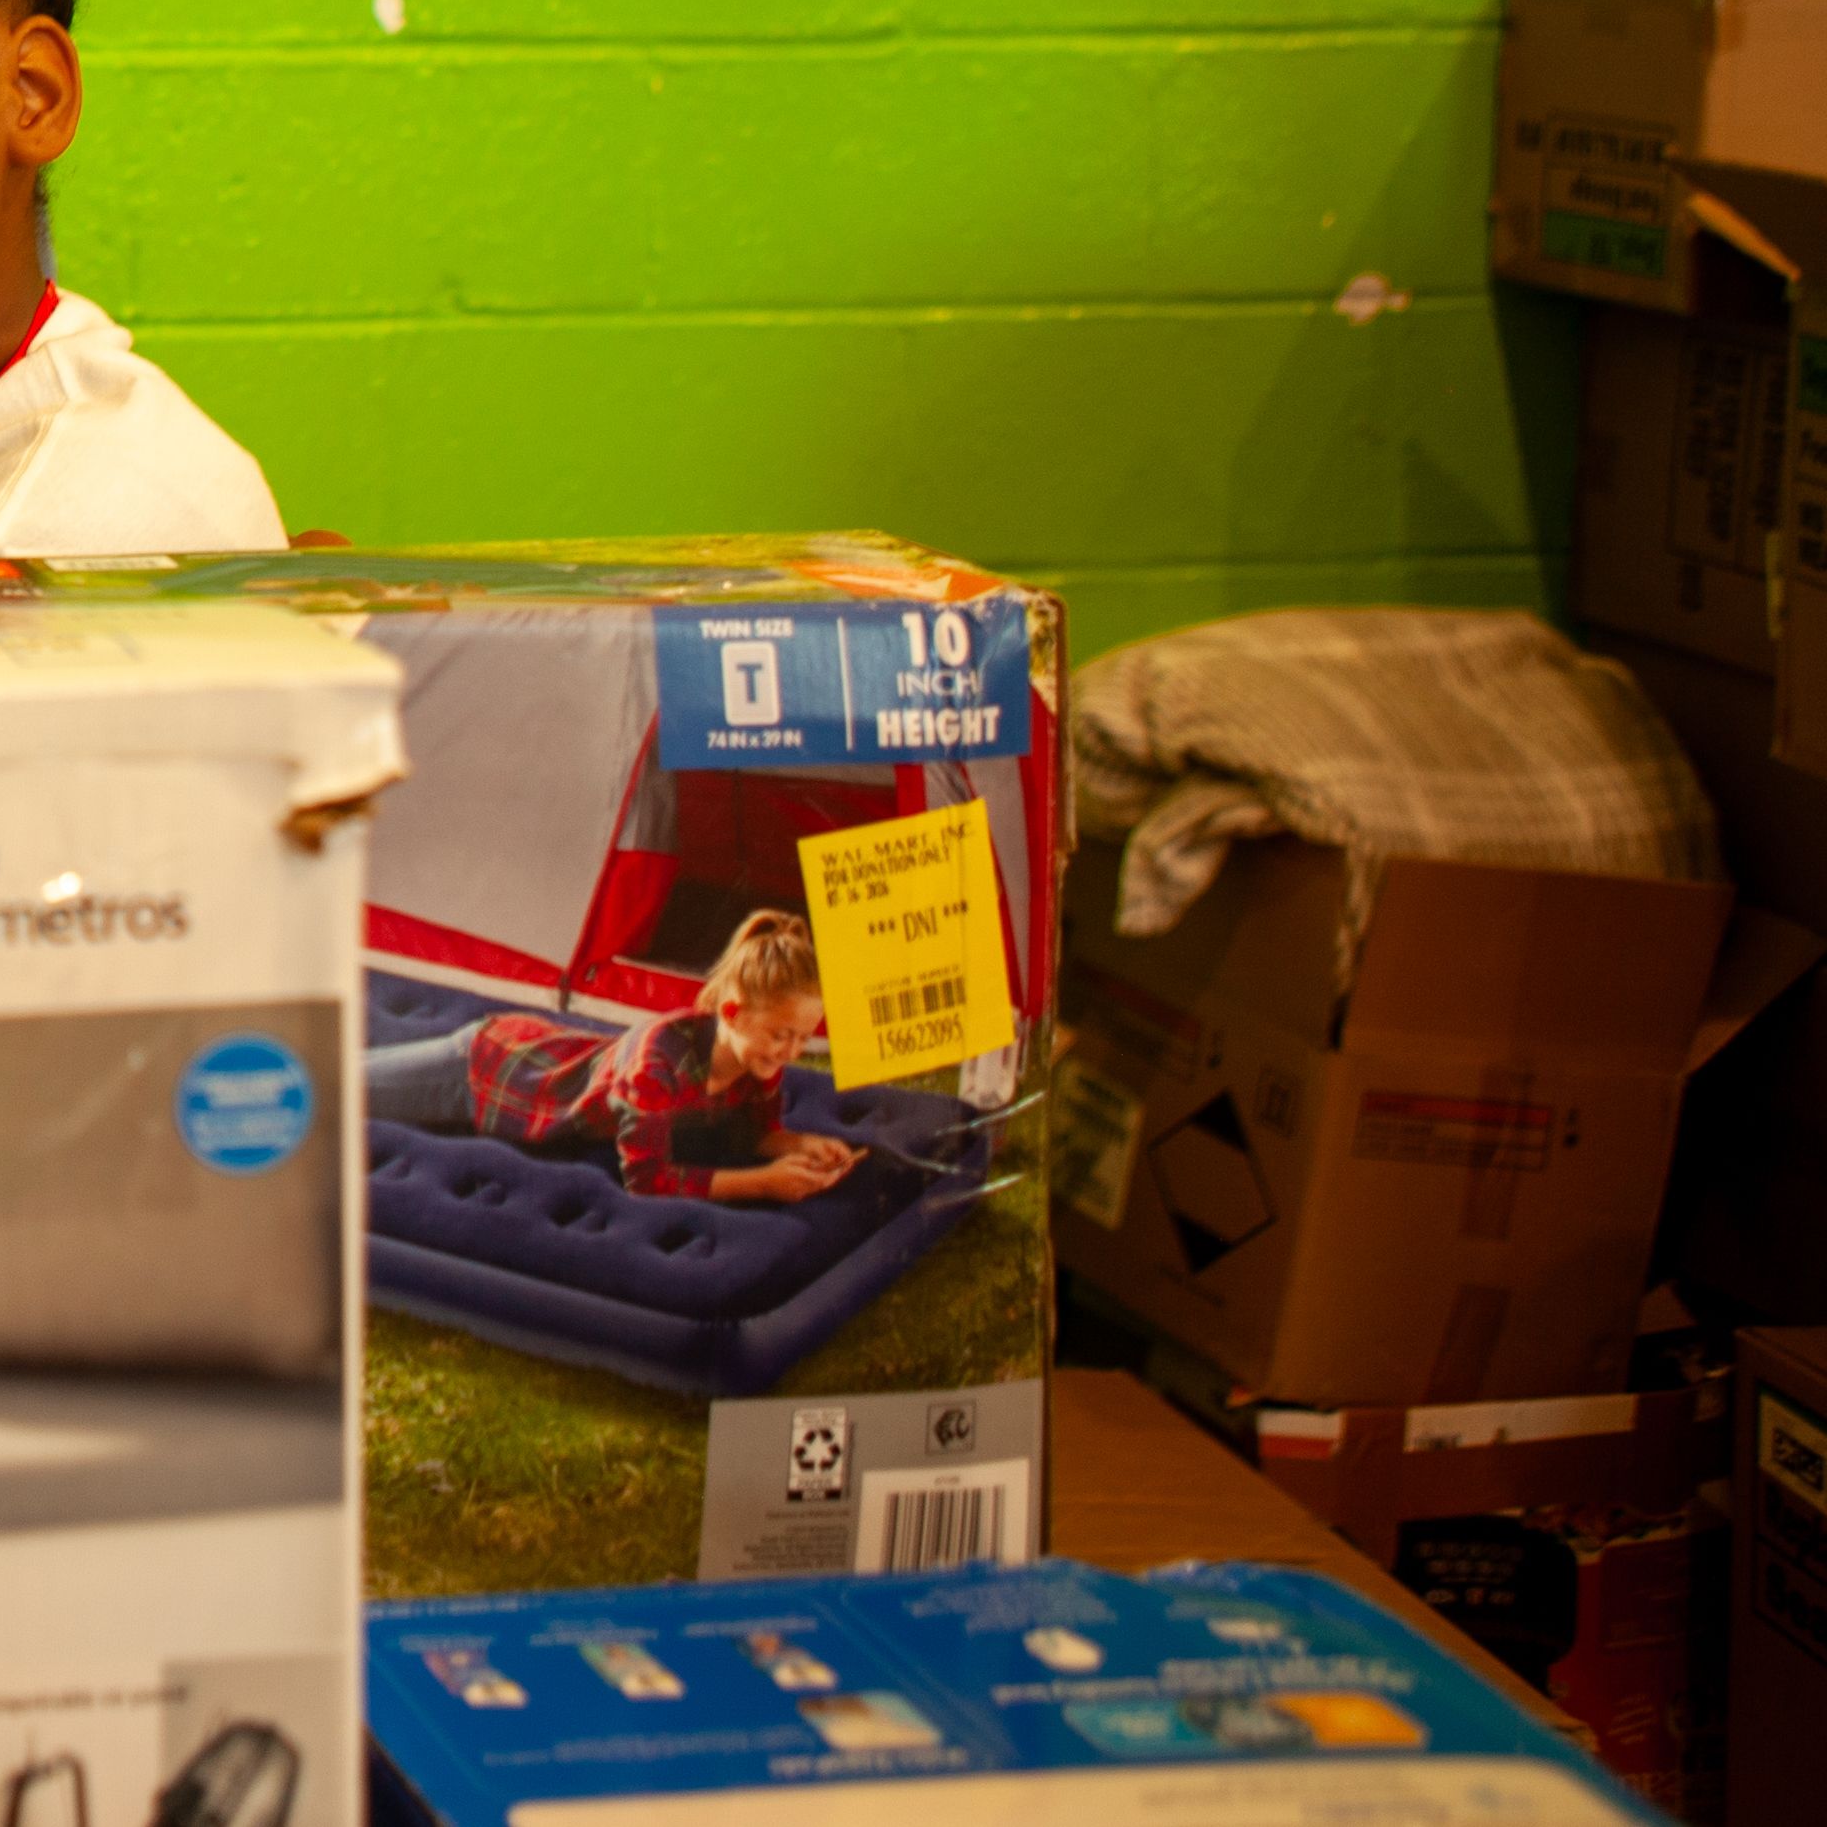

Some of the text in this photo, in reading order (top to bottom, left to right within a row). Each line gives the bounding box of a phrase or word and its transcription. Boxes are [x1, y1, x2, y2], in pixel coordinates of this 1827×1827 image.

[699, 617, 794, 639] TWIN SIZE
[902, 610, 973, 669] 10
[734, 661, 764, 706] T
[896, 671, 982, 698] INCH
[876, 705, 1001, 750] HEIGHT
